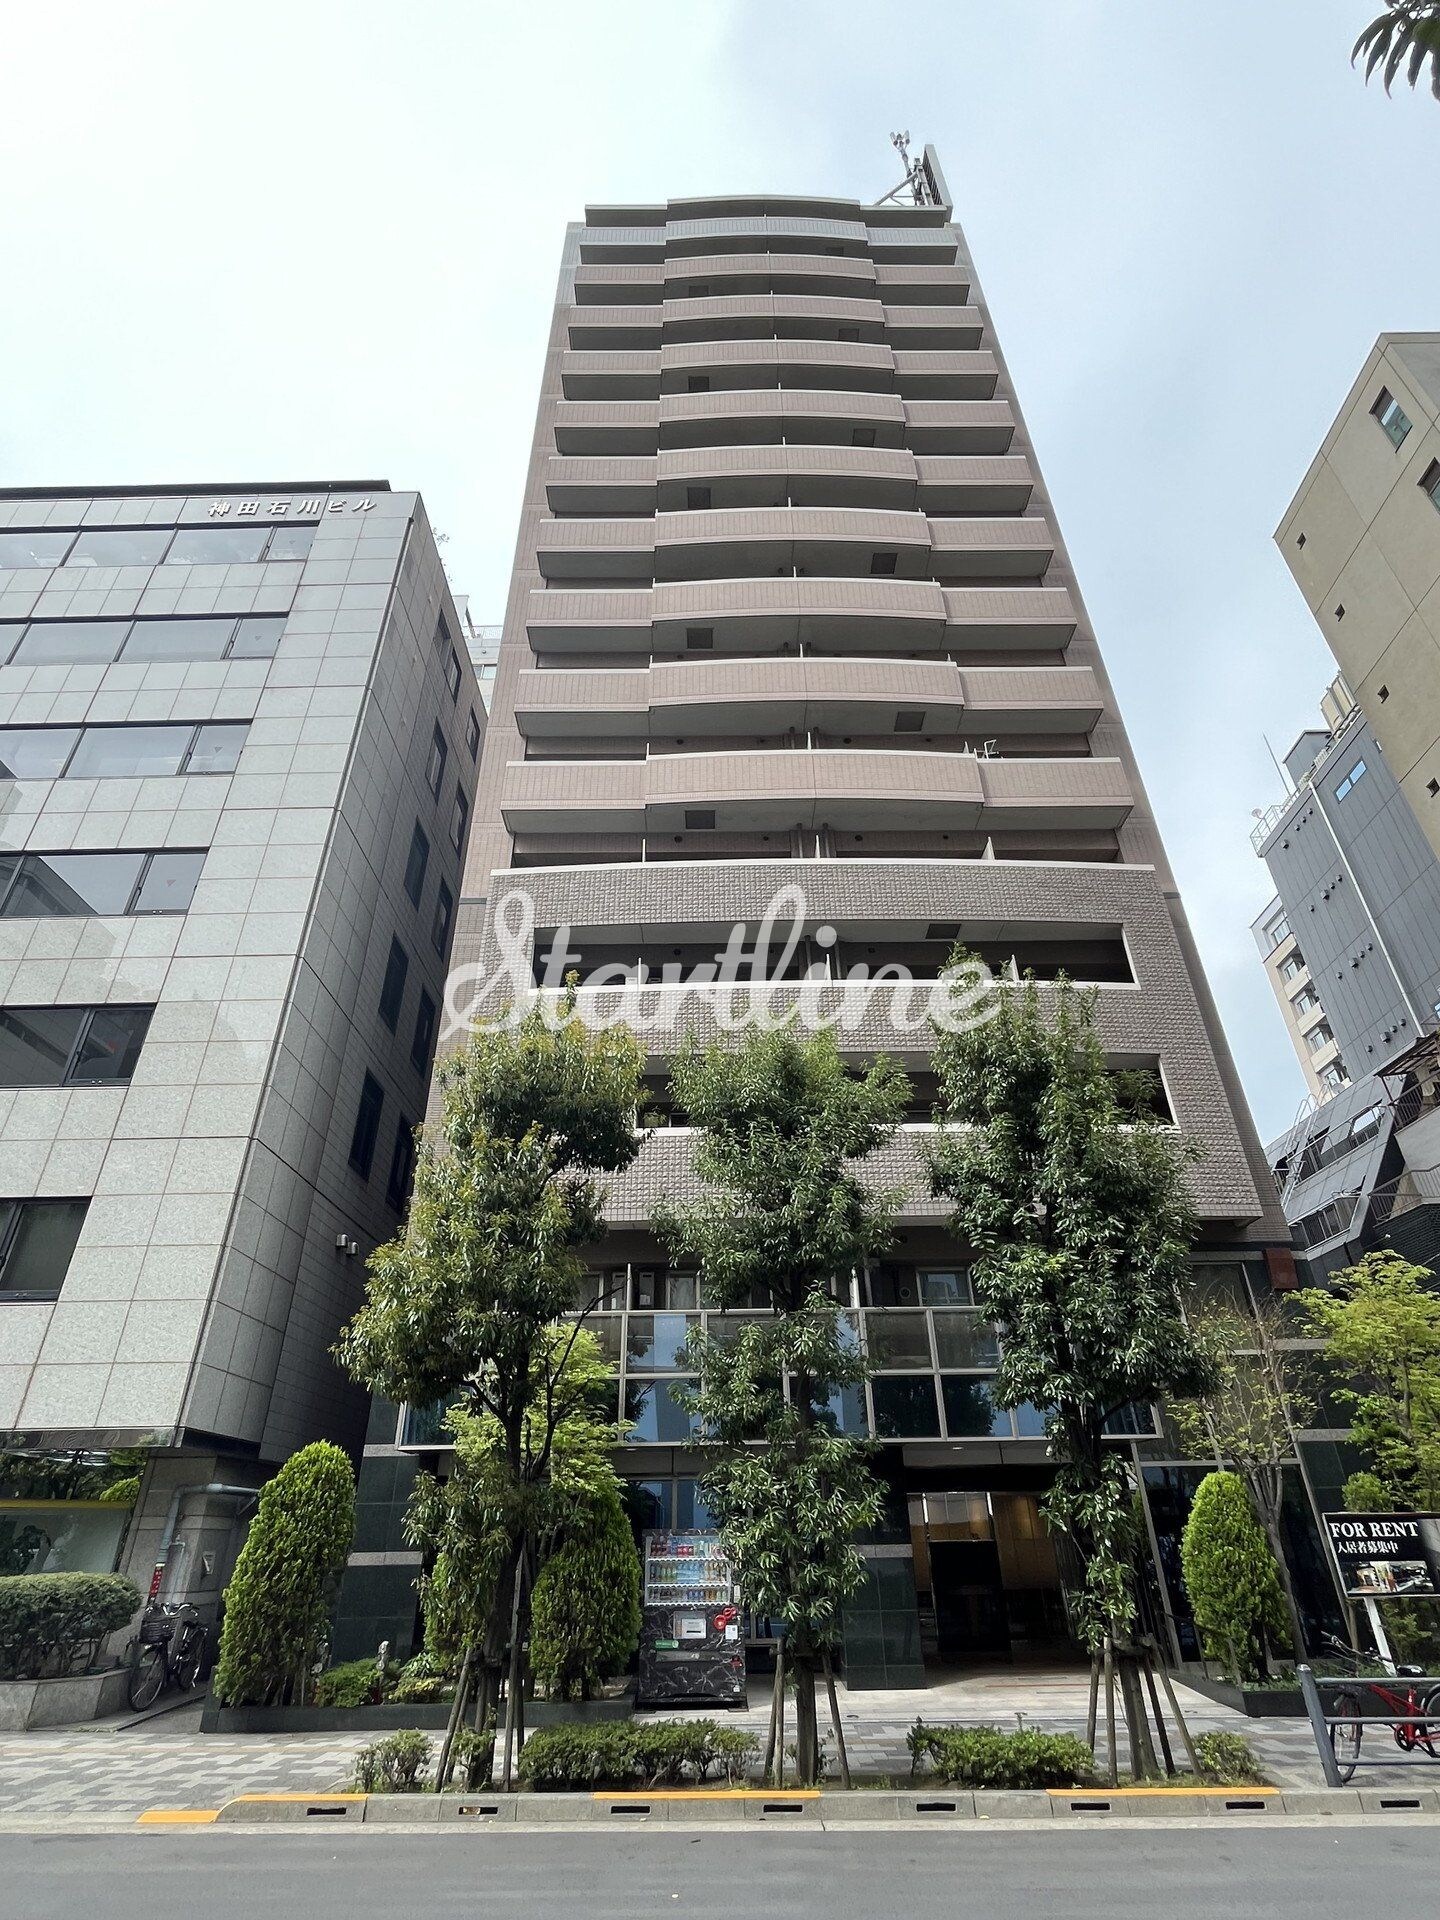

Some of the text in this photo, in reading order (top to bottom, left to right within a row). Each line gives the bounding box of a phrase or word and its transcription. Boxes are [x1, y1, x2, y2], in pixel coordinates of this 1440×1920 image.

[208, 498, 376, 516] 神田石川ビル
[1329, 1521, 1418, 1537] FOR RENT
